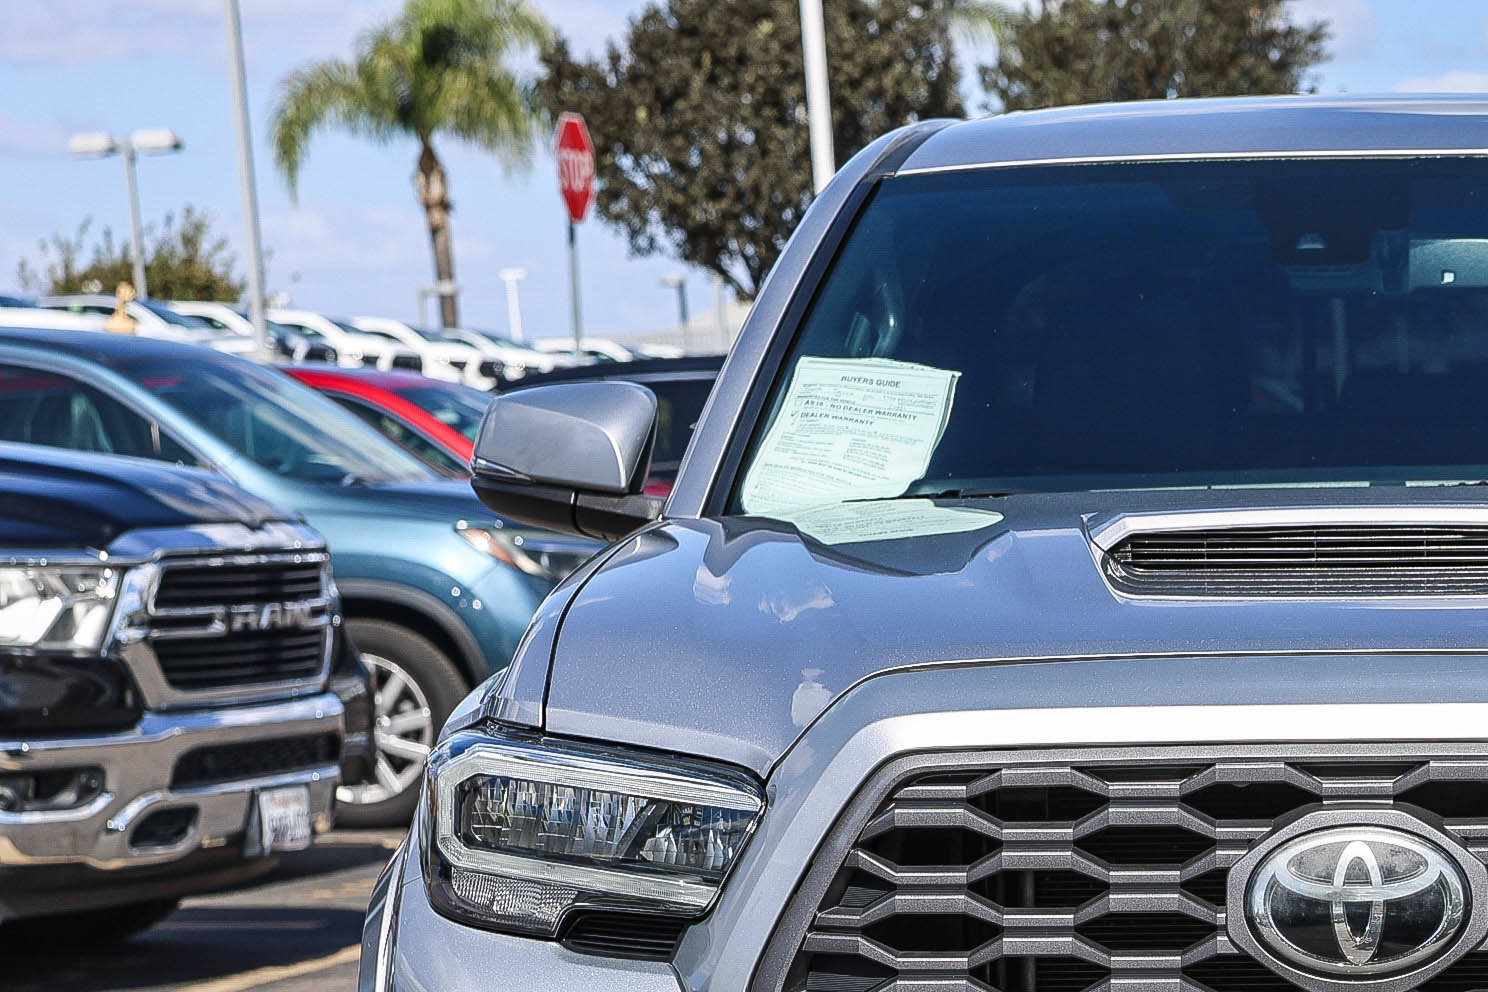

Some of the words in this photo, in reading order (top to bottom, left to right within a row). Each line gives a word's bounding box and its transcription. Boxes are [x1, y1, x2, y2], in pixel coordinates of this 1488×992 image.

[558, 149, 594, 191] STOP
[840, 375, 874, 387] BUYERS
[875, 378, 902, 389] GUIDE
[230, 600, 310, 633] RAM
